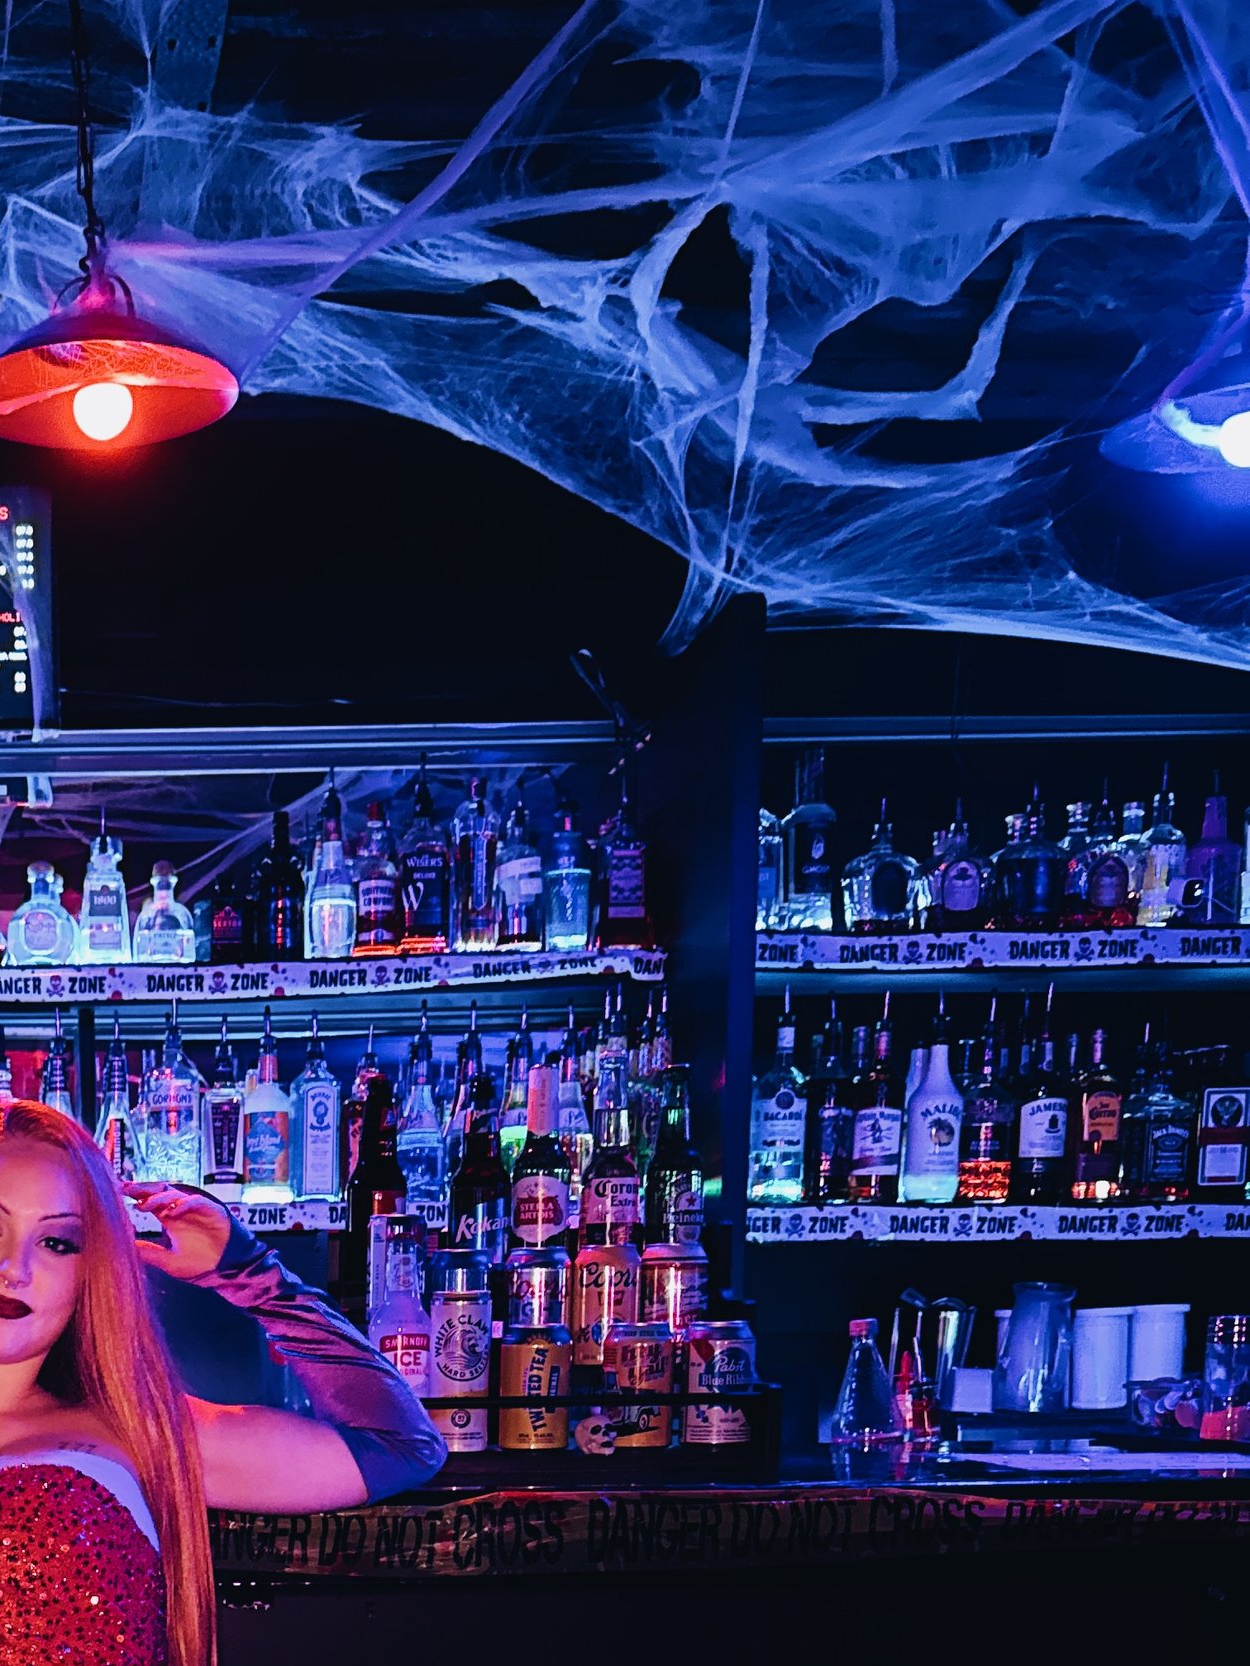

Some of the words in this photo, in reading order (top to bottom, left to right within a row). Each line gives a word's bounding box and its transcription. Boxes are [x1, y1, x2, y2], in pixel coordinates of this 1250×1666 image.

[758, 943, 799, 962] ZONE
[839, 943, 899, 963] DANGER
[926, 942, 968, 962] ZONE
[1009, 940, 1070, 960] DANGER
[1097, 939, 1138, 958] ZONE
[1180, 936, 1242, 956] DANGER
[309, 969, 367, 988] DANGER
[393, 966, 431, 984] ZONE
[472, 962, 532, 979] DANGER
[559, 957, 597, 970] ZONE
[68, 976, 106, 994] ZONE
[147, 974, 204, 993] DANGER
[230, 972, 269, 991] ZONE
[594, 1180, 639, 1198] Coron
[248, 1207, 287, 1225] ZONE
[415, 1204, 447, 1221] ZON
[662, 1212, 704, 1224] Heinek
[455, 1214, 510, 1243] Kokan
[808, 1216, 850, 1234] ZONE
[890, 1215, 950, 1234] DANGER
[976, 1215, 1018, 1233] ZONE
[1058, 1214, 1119, 1233] DANGER
[1144, 1214, 1186, 1233] ZONE
[580, 1262, 636, 1288] Coor
[385, 1337, 428, 1349] SMRNOFF
[434, 1318, 456, 1358] WHITE
[393, 1351, 422, 1367] ICE
[726, 1373, 747, 1386] Ribb
[209, 1510, 313, 1565] ANGER
[374, 1511, 439, 1568] NOT
[452, 1501, 566, 1569] CROSS
[586, 1496, 723, 1566] DANGER
[869, 1495, 987, 1550] CROSS
